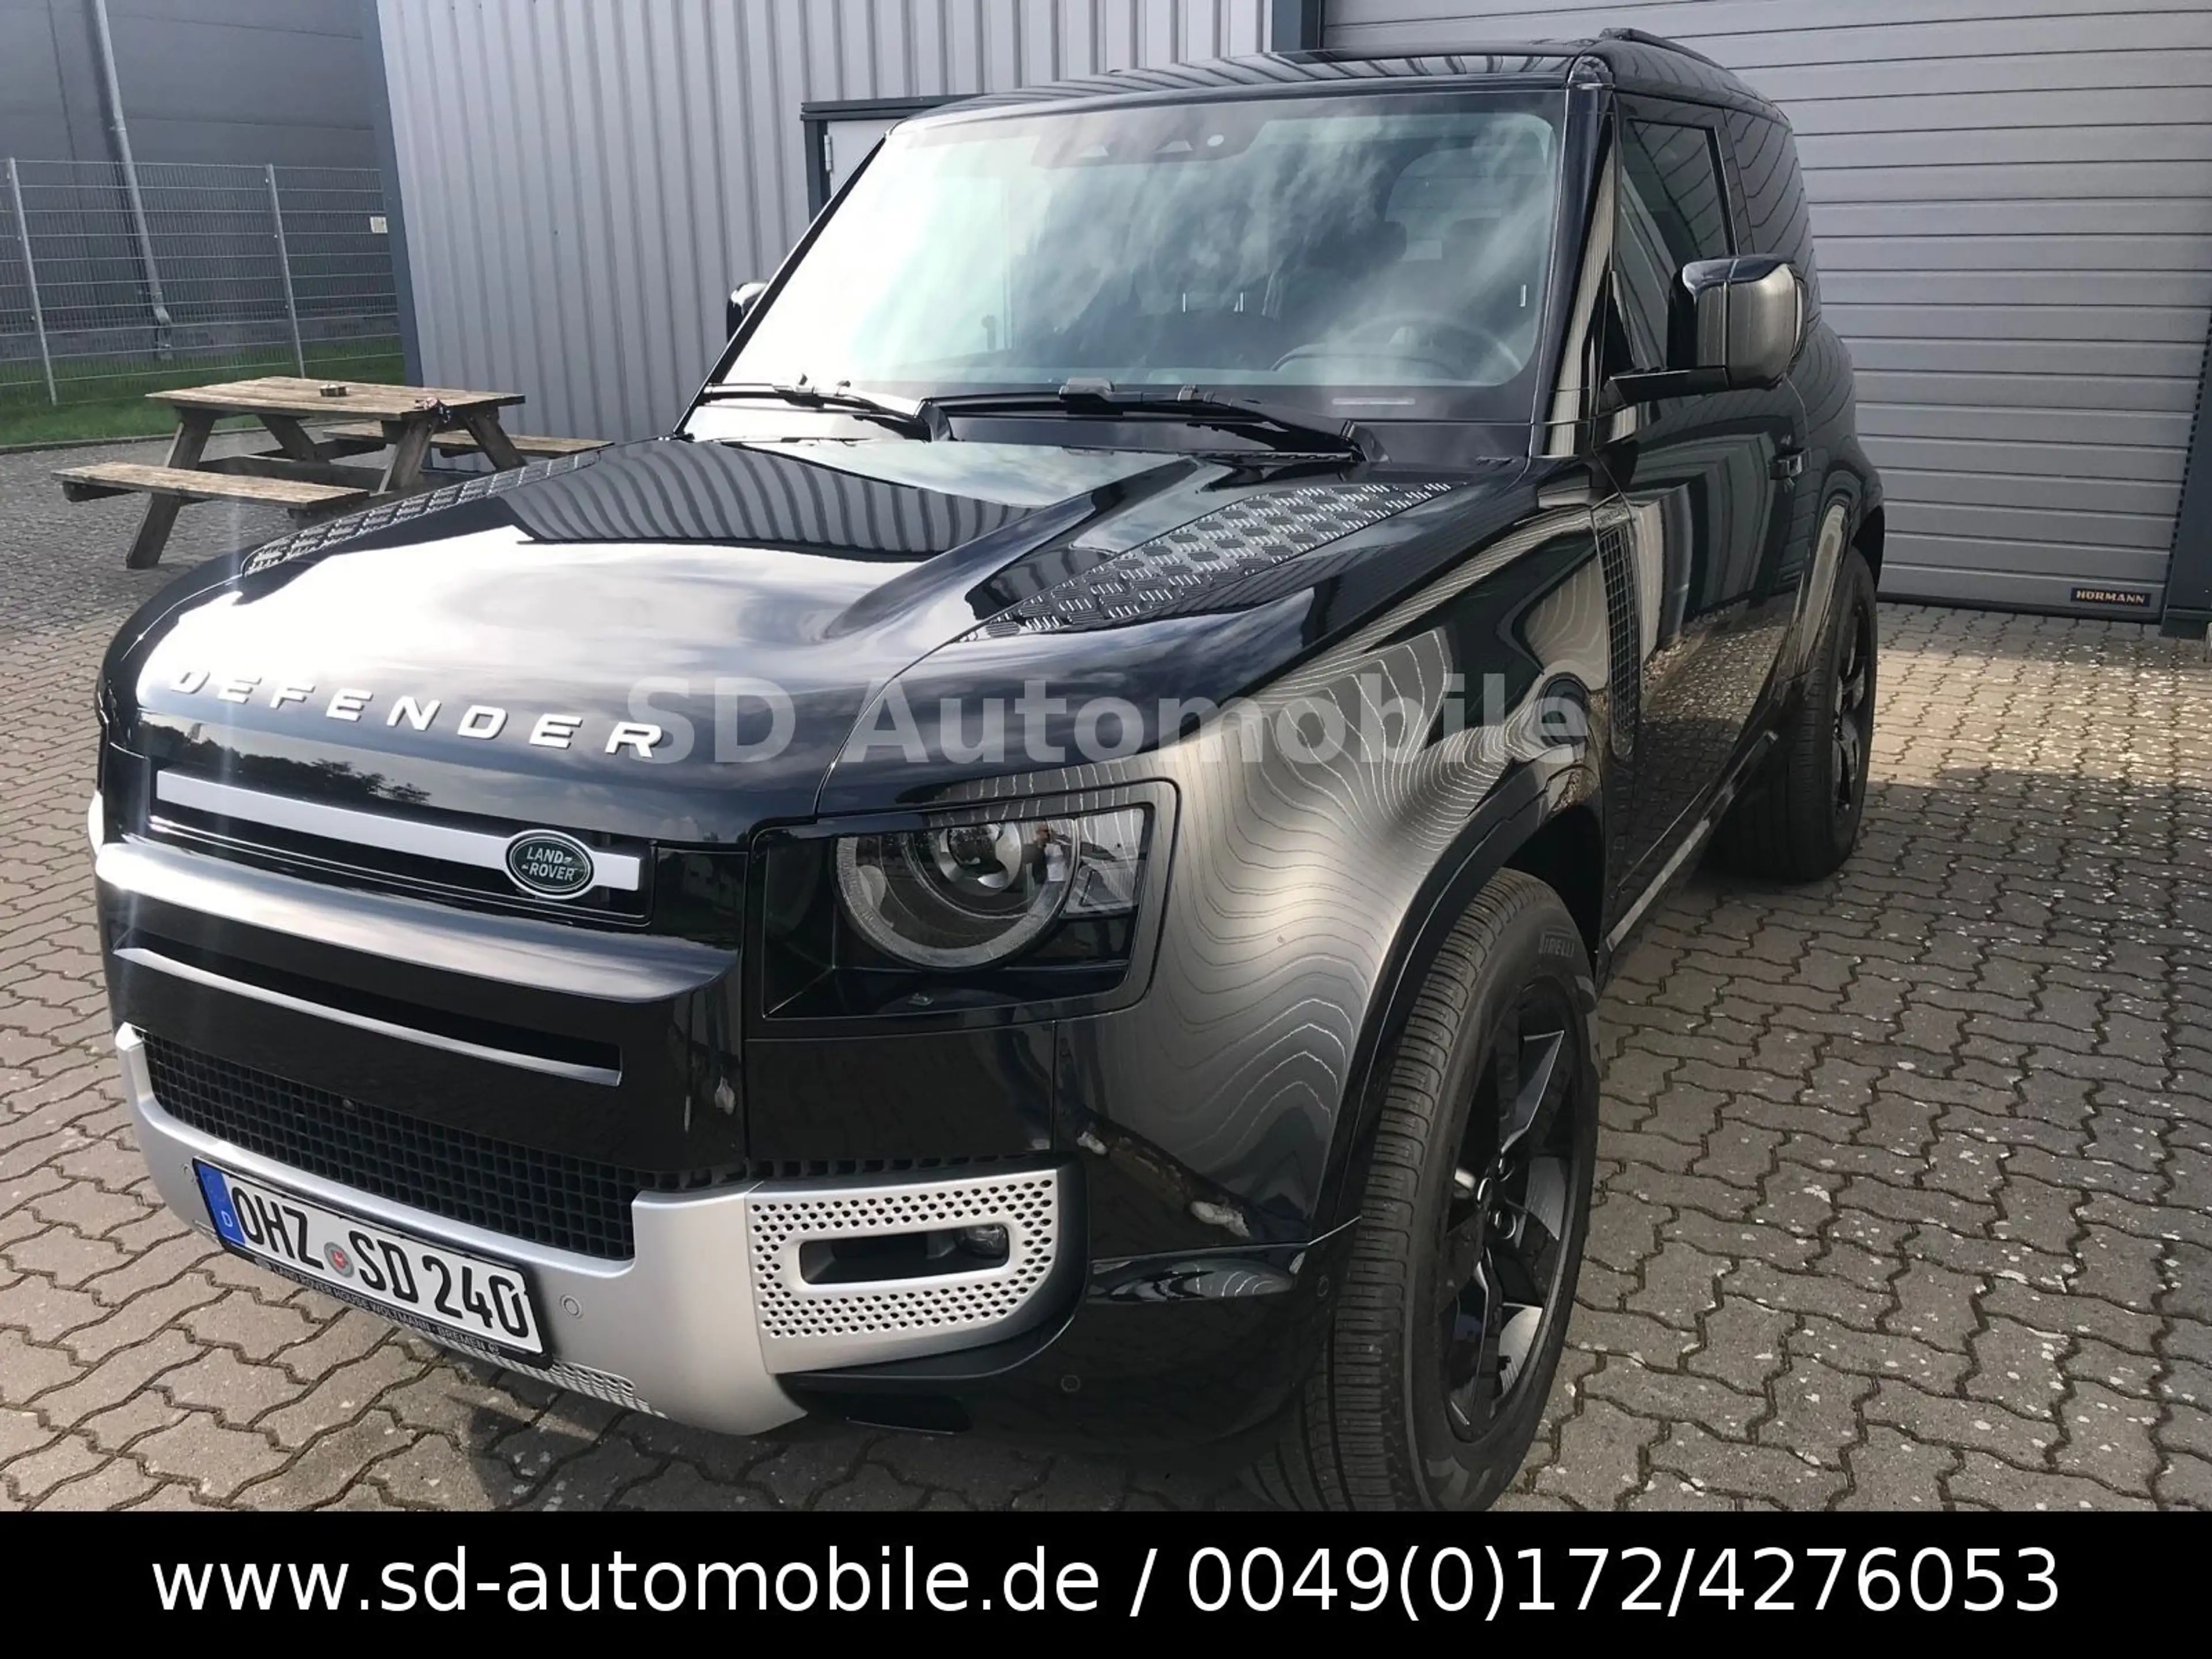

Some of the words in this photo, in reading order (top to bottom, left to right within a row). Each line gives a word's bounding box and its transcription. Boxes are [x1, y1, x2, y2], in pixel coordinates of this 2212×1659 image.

[169, 670, 662, 758] DEFENDER
[527, 846, 563, 864] LAND
[528, 862, 575, 882] ROVER
[221, 1210, 234, 1228] D
[232, 1187, 324, 1271] OHZ
[349, 1230, 419, 1304] SD
[422, 1255, 529, 1338] 240
